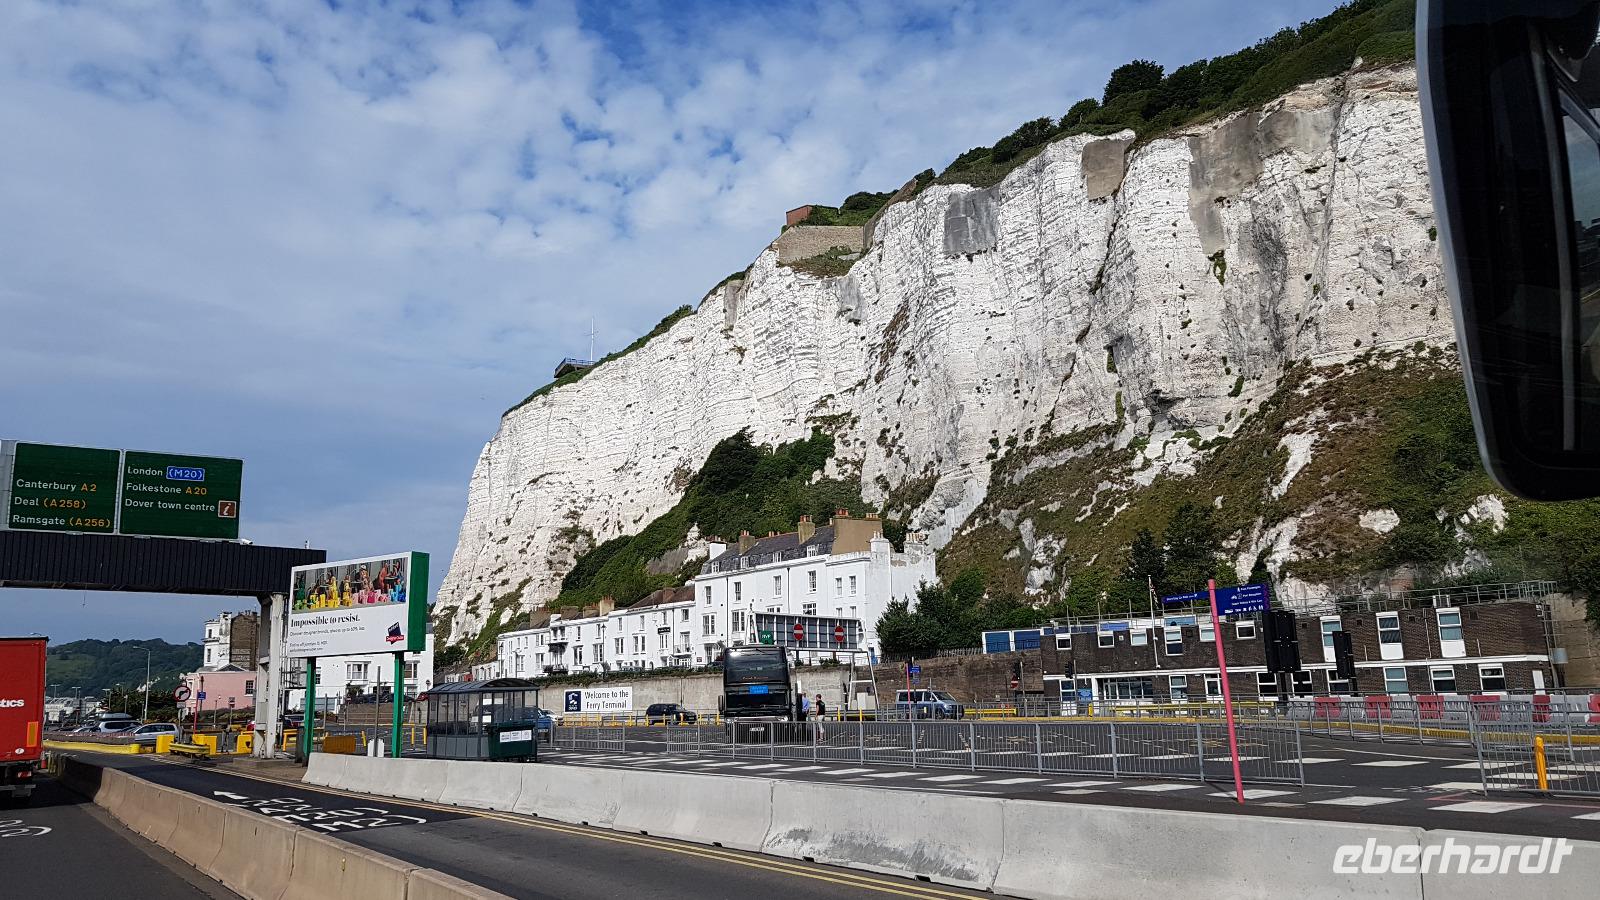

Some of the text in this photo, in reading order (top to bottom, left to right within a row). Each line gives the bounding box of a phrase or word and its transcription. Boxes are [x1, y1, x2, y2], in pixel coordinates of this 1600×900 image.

[128, 466, 203, 479] London (M20)
[16, 479, 97, 492] Canterbury A2
[126, 482, 207, 495] Folkestone A20
[14, 497, 87, 509] Deal (A258)
[125, 499, 216, 512] Dover town centre
[13, 515, 111, 528] Ramsgate (A256)
[291, 613, 361, 628] Impossible to resist.
[585, 690, 610, 699] Welcome
[620, 690, 629, 698] the
[0, 699, 25, 708] tics
[586, 701, 601, 710] Ferry
[602, 700, 627, 709] Terminal
